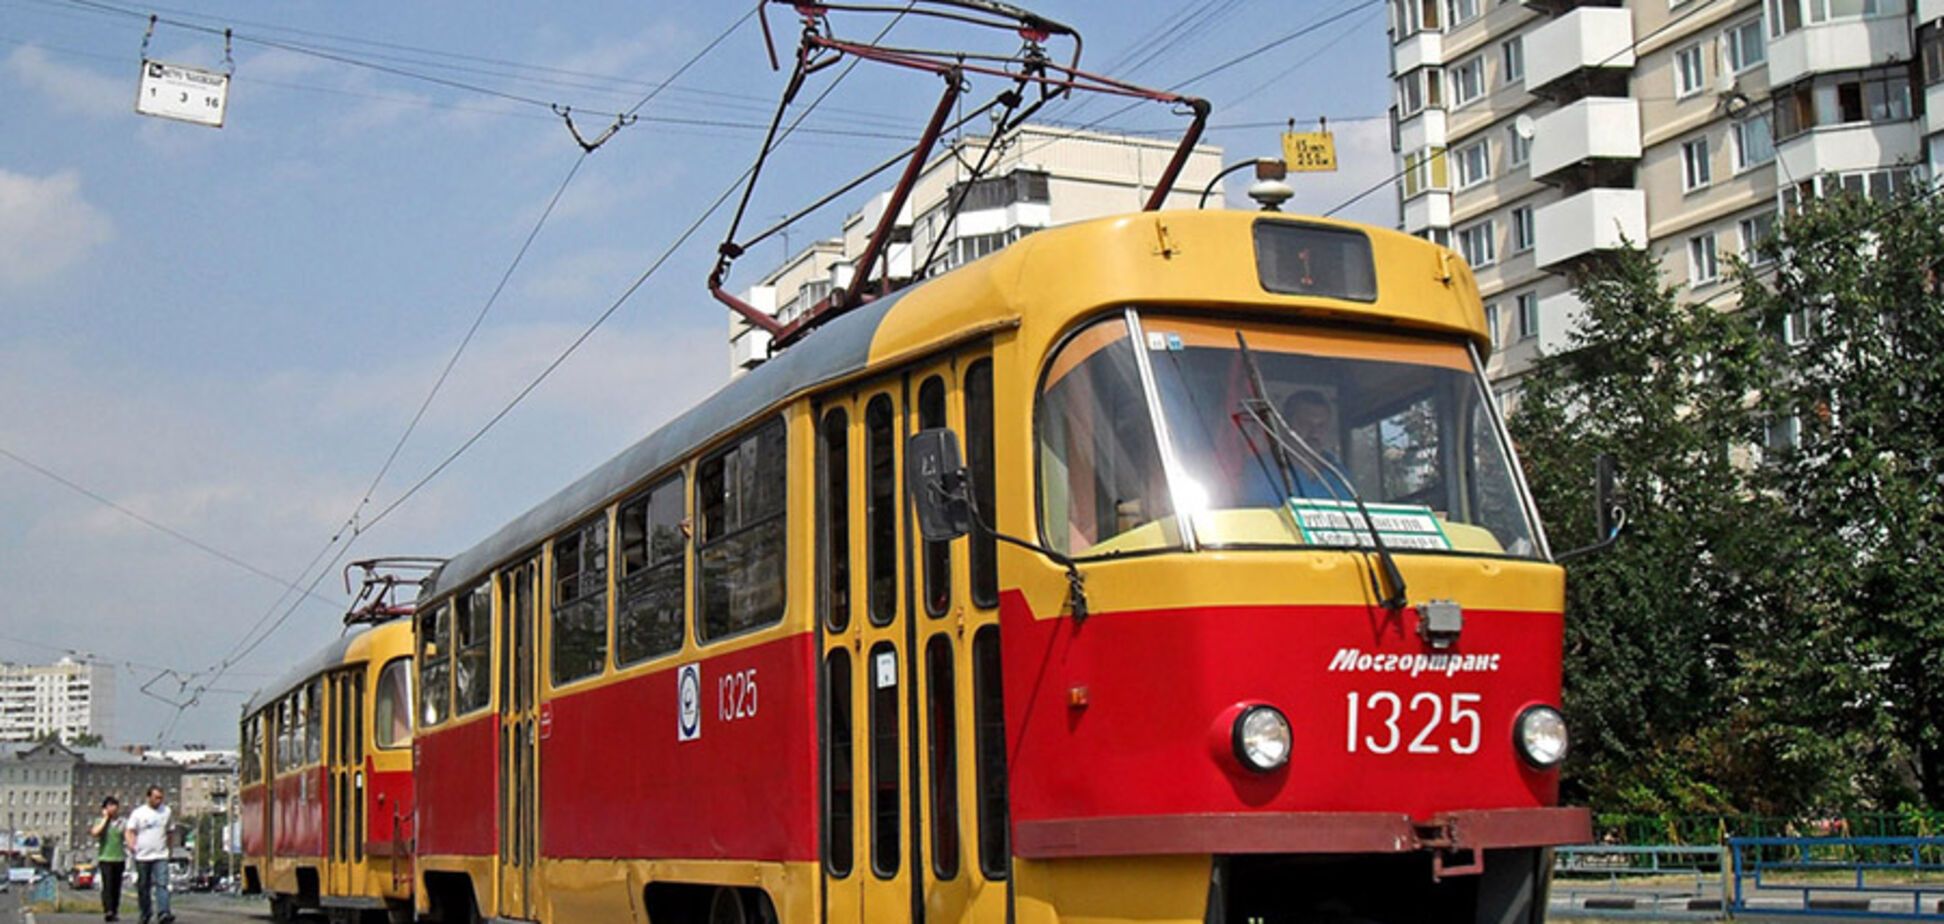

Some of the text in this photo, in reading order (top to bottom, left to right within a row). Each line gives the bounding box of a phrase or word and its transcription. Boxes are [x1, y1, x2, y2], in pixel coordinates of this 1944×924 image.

[150, 87, 156, 97] 1
[205, 97, 218, 108] 16
[1328, 649, 1501, 678] Мосгортранс
[718, 668, 758, 721] 1325
[1347, 691, 1481, 755] 1325
